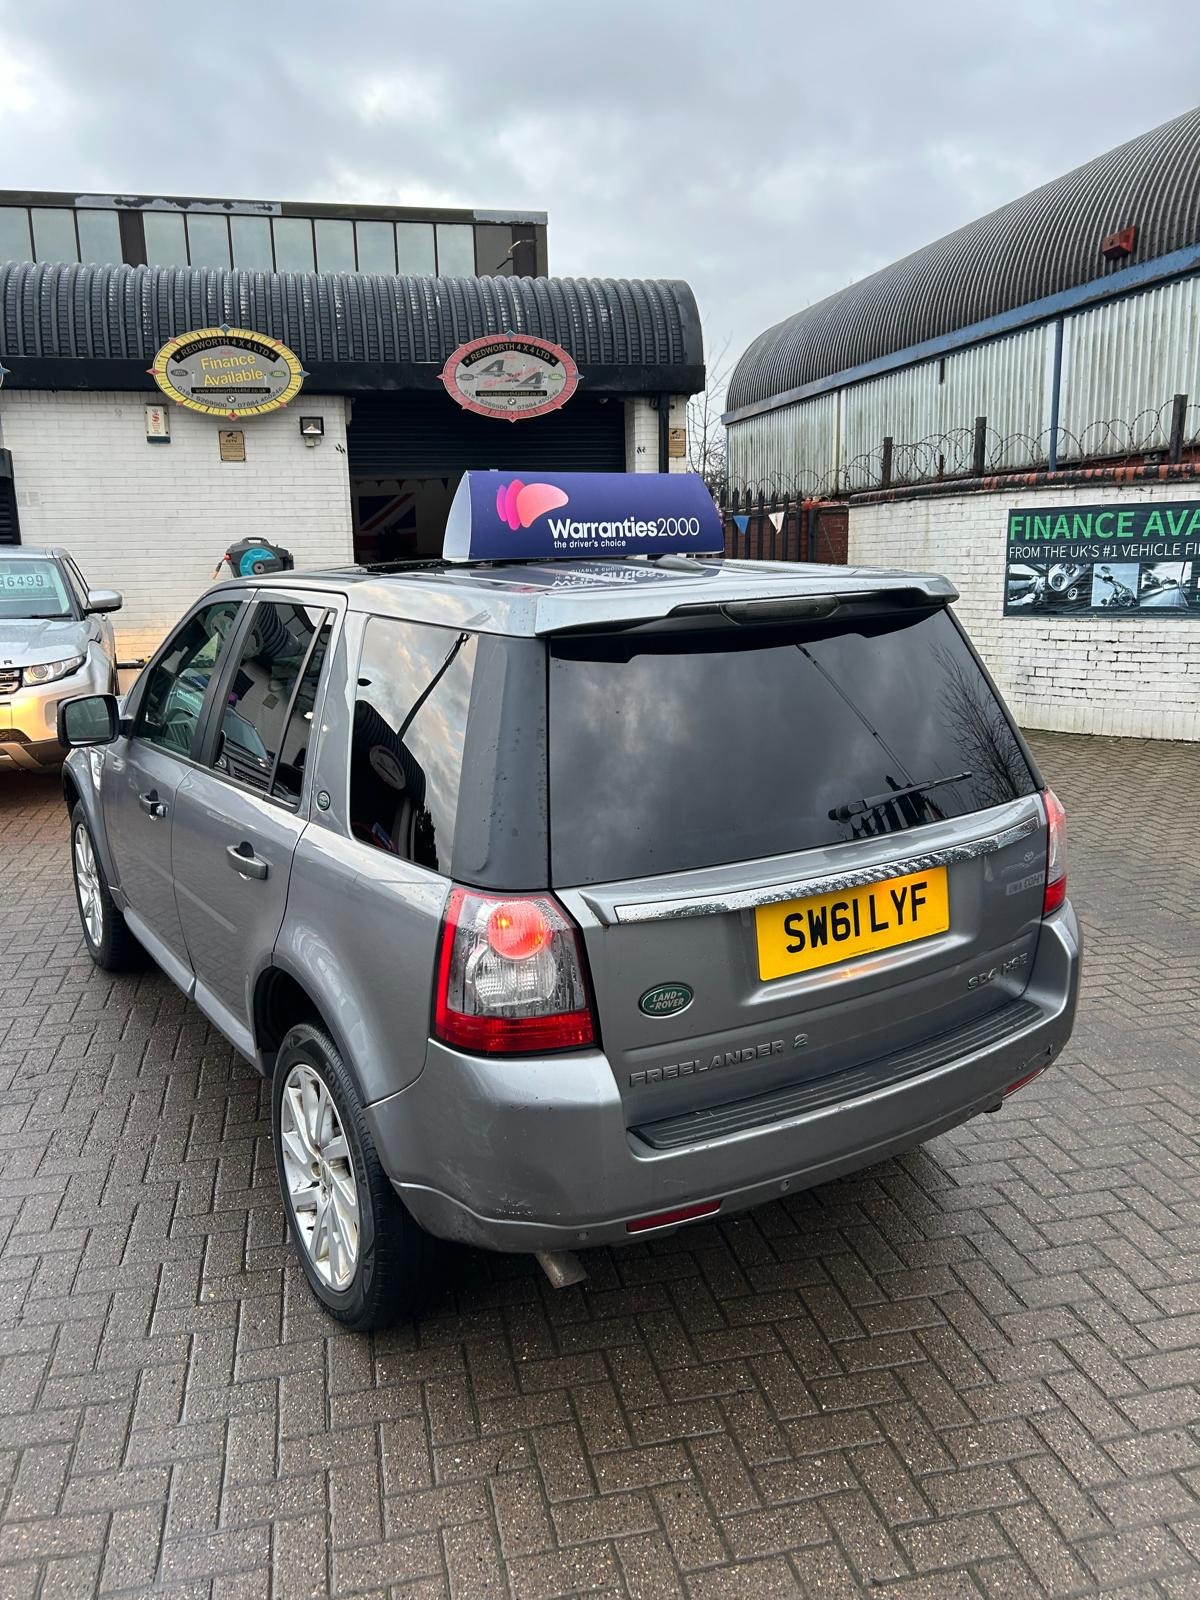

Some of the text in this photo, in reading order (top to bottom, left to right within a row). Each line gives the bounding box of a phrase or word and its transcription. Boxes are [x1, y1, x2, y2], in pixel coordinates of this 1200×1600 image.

[180, 338, 230, 357] REDWORTH
[253, 343, 269, 356] LTD
[470, 343, 515, 360] REDWORTH
[523, 344, 529, 352] X
[535, 348, 550, 360] LTD
[200, 354, 256, 370] Finance
[204, 368, 263, 387] Available
[548, 516, 700, 539] Warranties2000
[1009, 511, 1135, 541] FINANCE
[554, 539, 626, 548] the driver's choice
[1009, 542, 1200, 559] FROM THE UK'S #1 VEHICLE FI
[784, 881, 928, 954] SW61 LYF
[629, 1033, 809, 1088] FREELANDER 2
